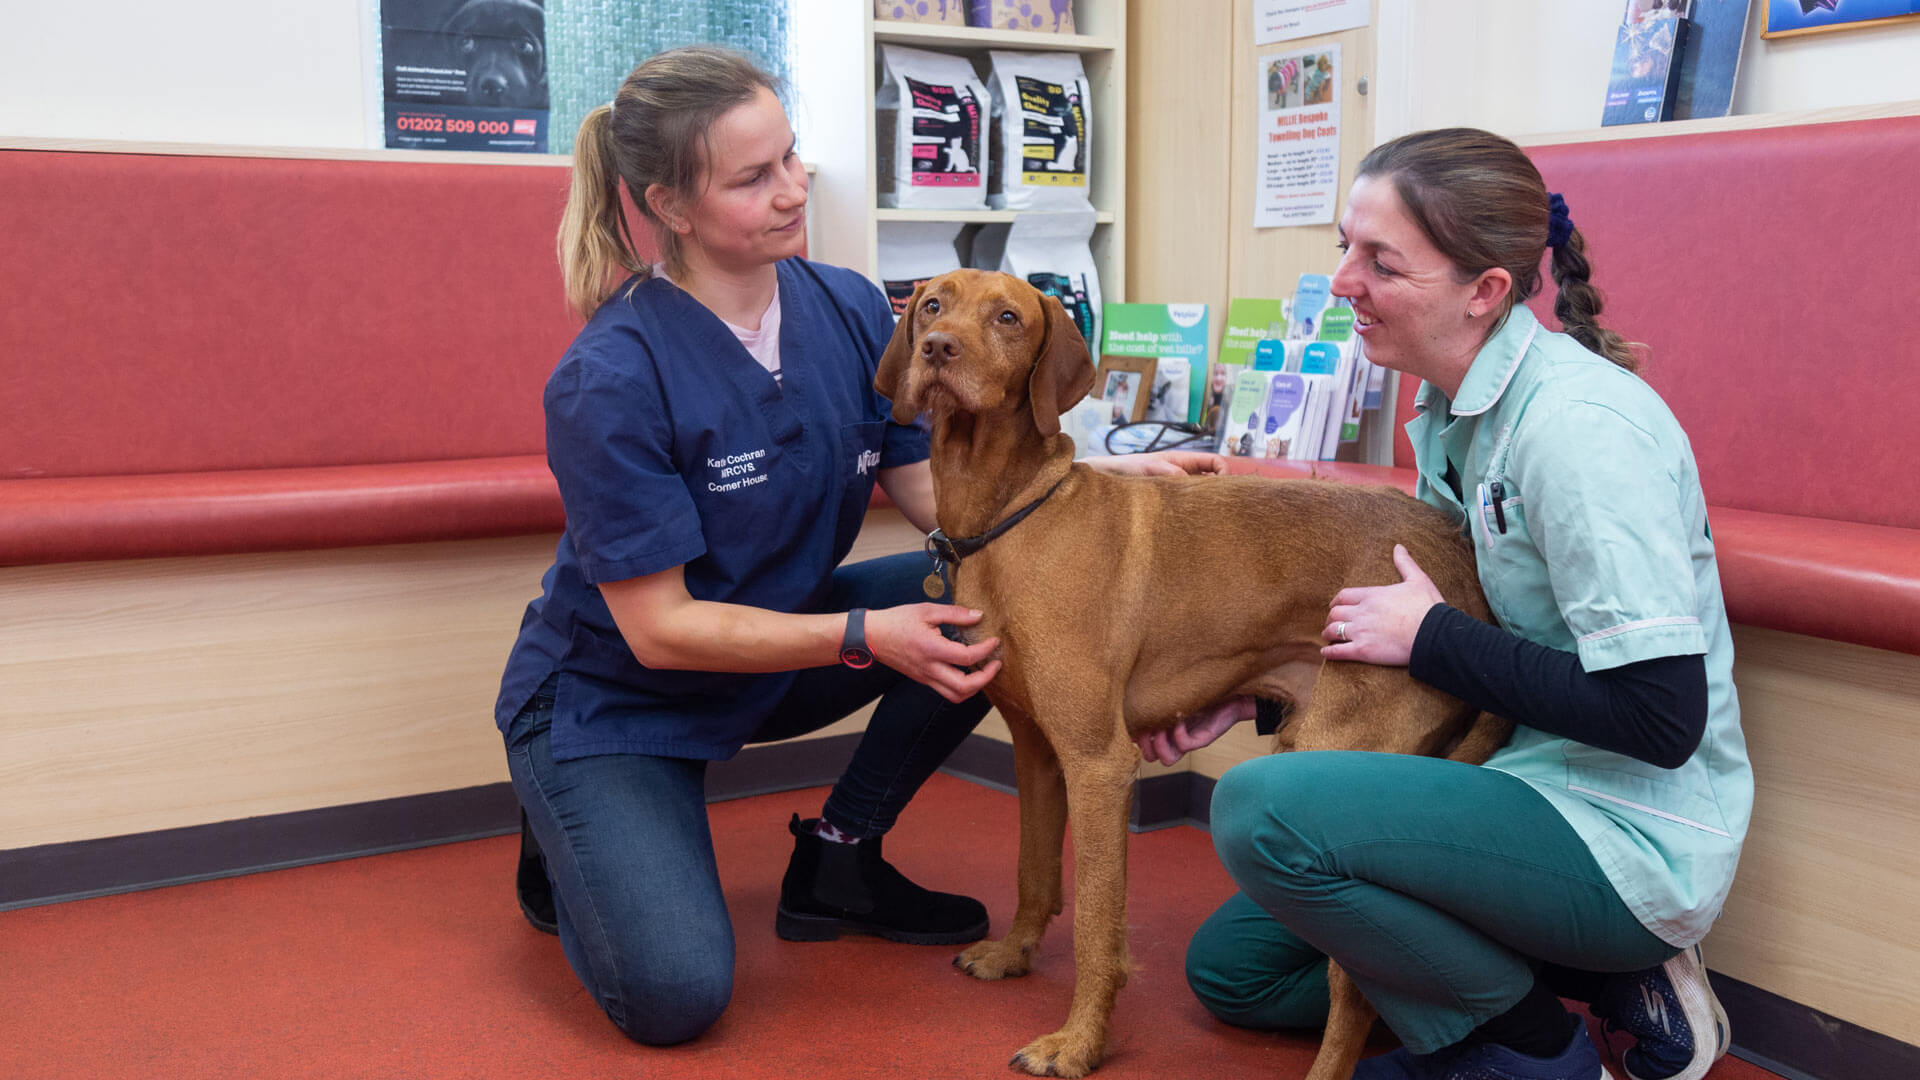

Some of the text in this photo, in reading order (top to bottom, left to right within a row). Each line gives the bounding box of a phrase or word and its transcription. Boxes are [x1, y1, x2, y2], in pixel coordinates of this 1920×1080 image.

[397, 117, 443, 132] 01202
[446, 119, 475, 133] 509
[478, 120, 510, 135] 000
[1277, 112, 1328, 127] MILLIE Bespoke
[1269, 127, 1336, 144] Towelling Dog Coats
[1109, 330, 1183, 344] Need help with
[1109, 344, 1124, 352] the
[1126, 344, 1144, 352] cost
[1148, 344, 1158, 352] of
[1160, 345, 1174, 353] vet
[727, 448, 766, 465] Cochran
[708, 474, 768, 492] Corner House
